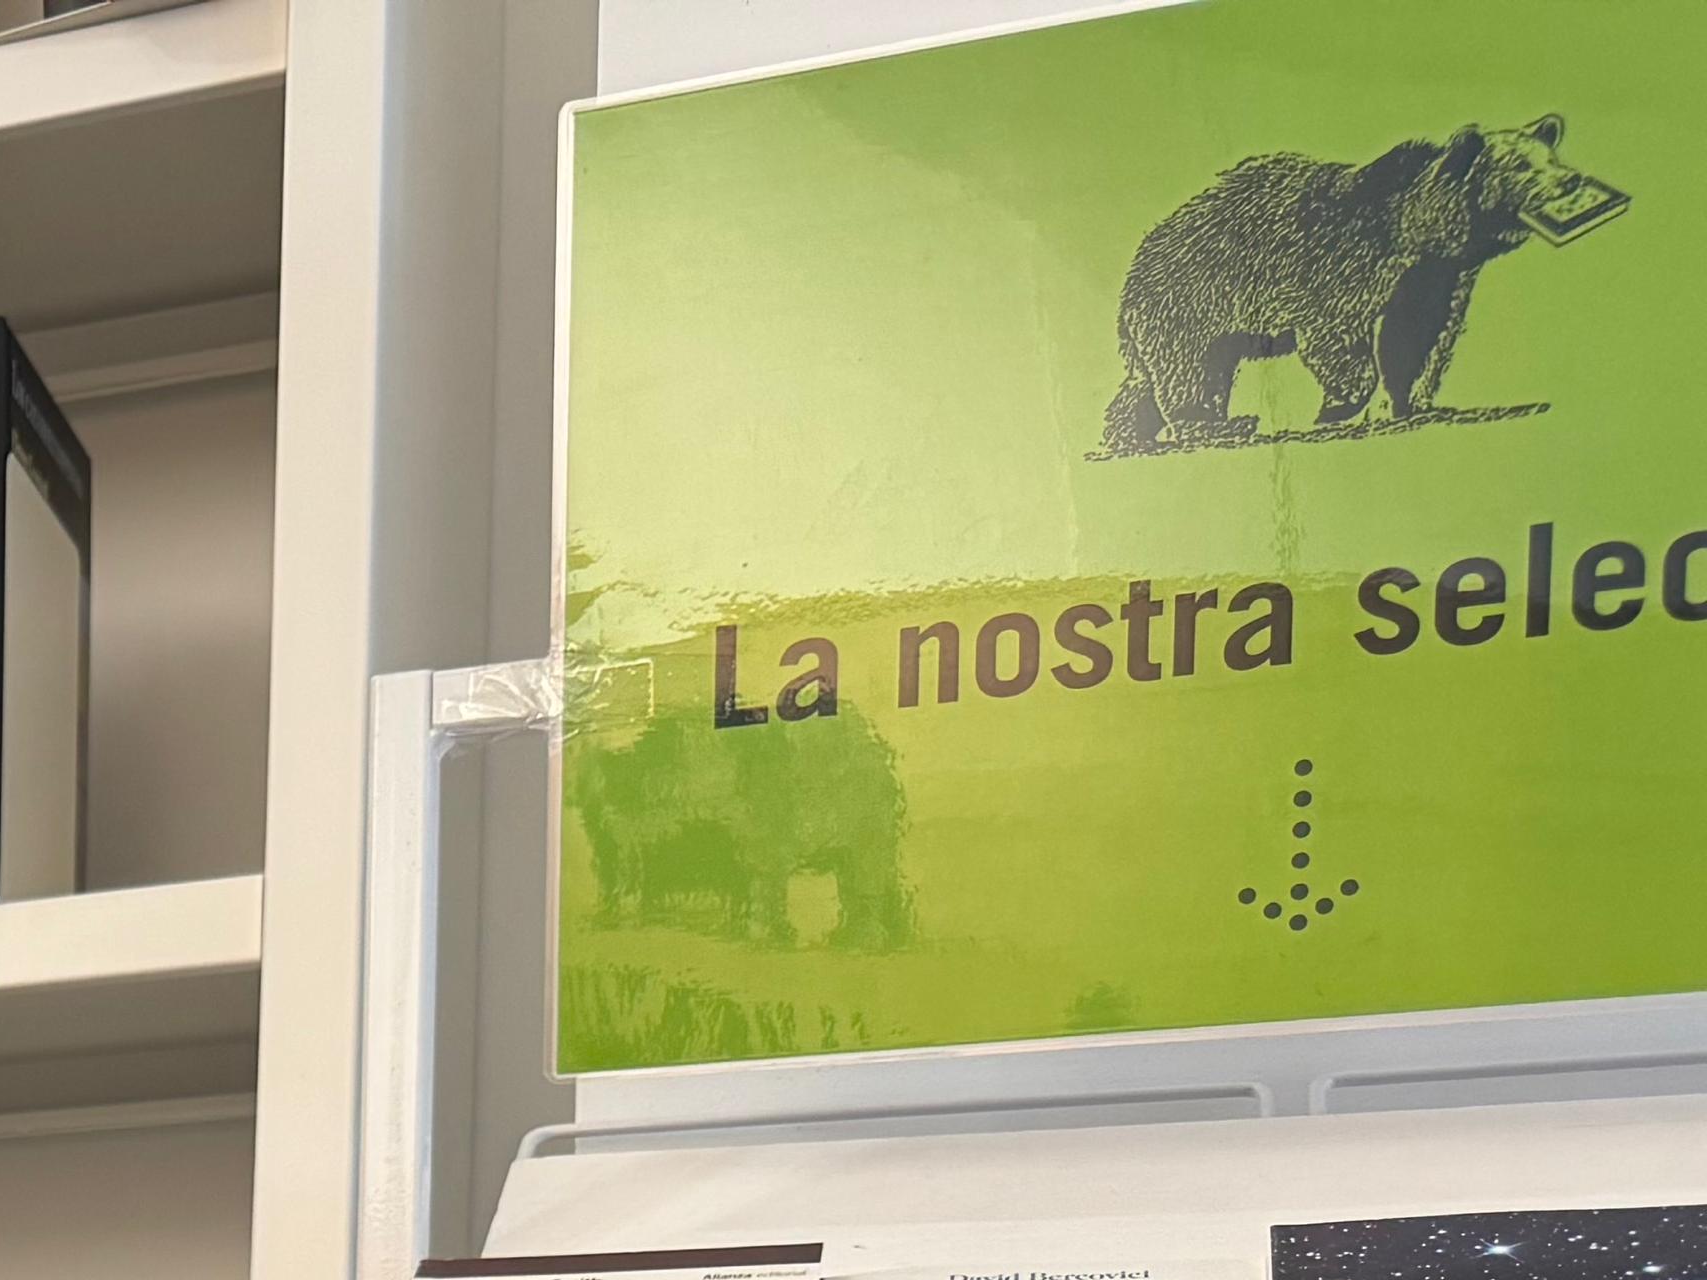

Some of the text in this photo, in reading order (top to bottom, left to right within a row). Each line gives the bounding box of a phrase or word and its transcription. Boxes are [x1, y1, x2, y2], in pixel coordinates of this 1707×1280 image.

[713, 522, 1707, 731] La nostra selec
